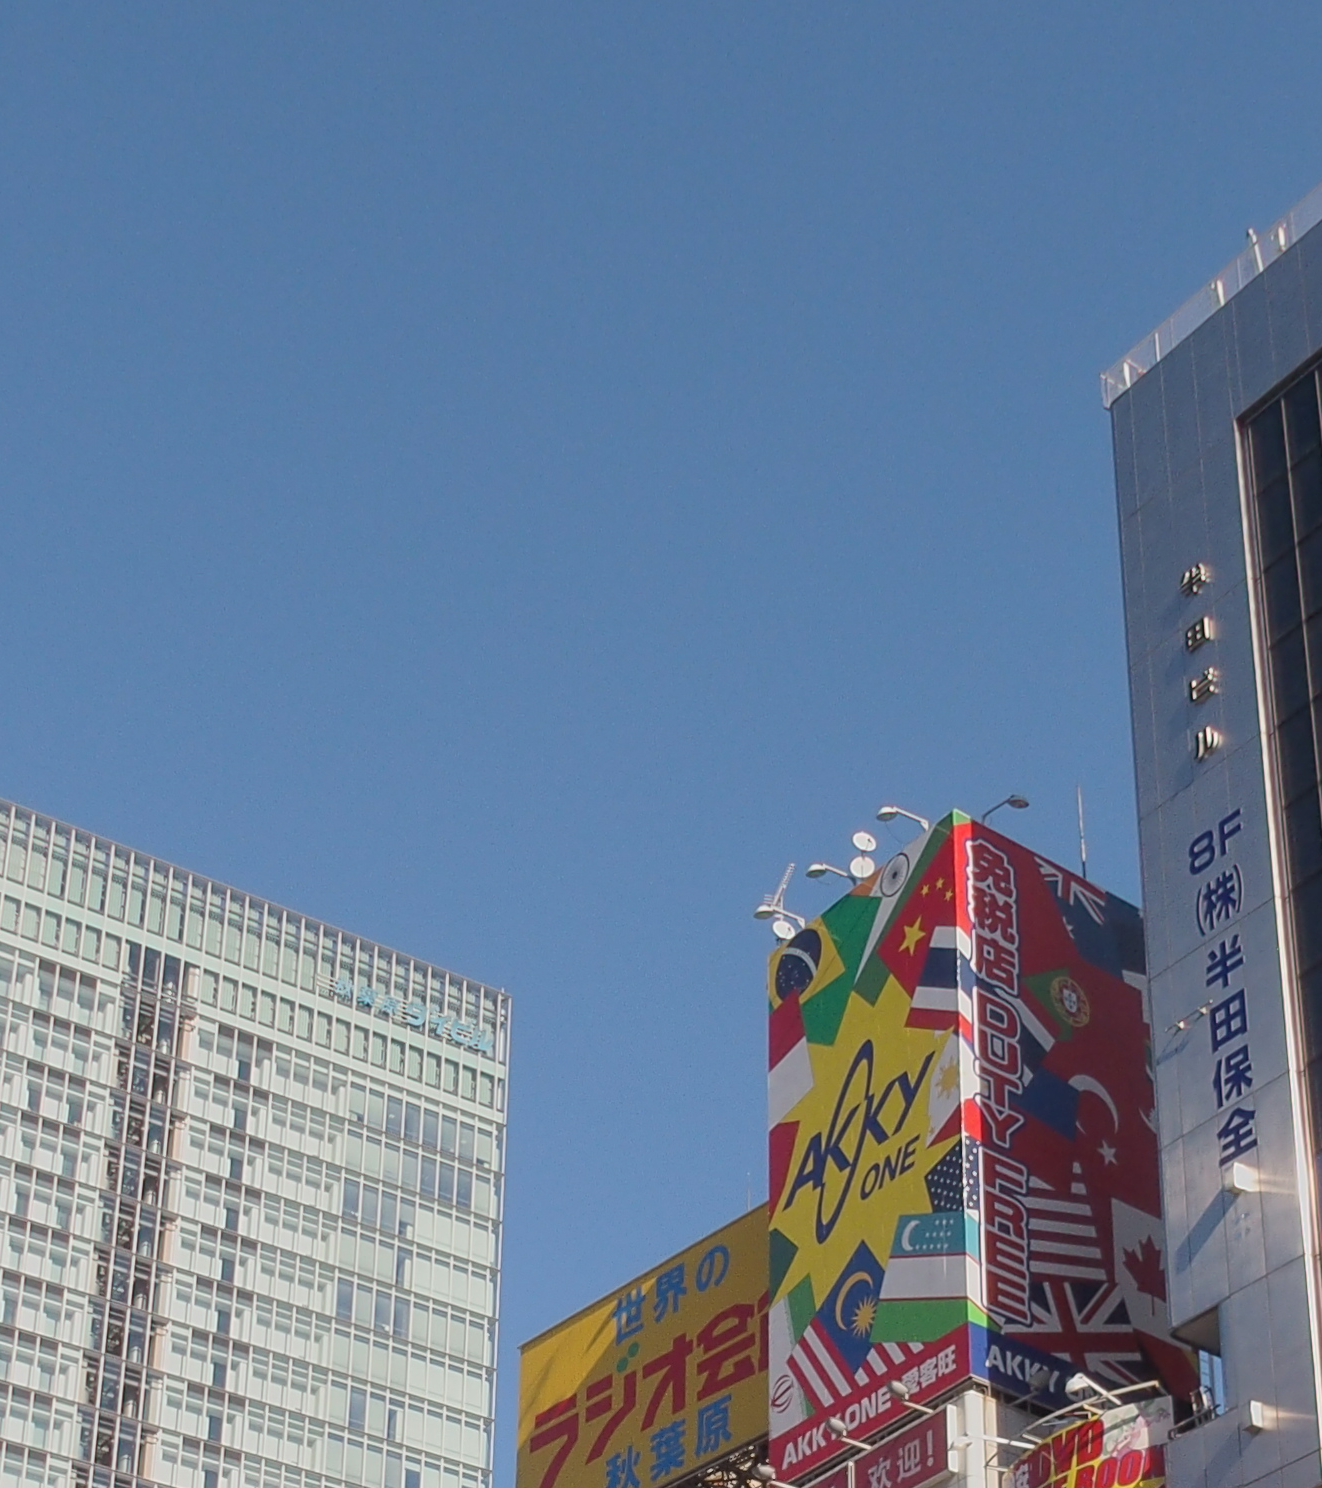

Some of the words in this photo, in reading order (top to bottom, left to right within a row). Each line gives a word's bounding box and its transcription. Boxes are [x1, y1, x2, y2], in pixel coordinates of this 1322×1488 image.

[1179, 563, 1223, 760] 半田ビル
[1189, 808, 1244, 876] 8F
[967, 839, 1020, 996] 免税店
[976, 990, 1024, 1148] DUTY
[862, 1135, 920, 1202] ONE
[612, 1244, 731, 1347] 世界の
[979, 1147, 1033, 1328] FREE
[842, 1390, 891, 1431] ONE
